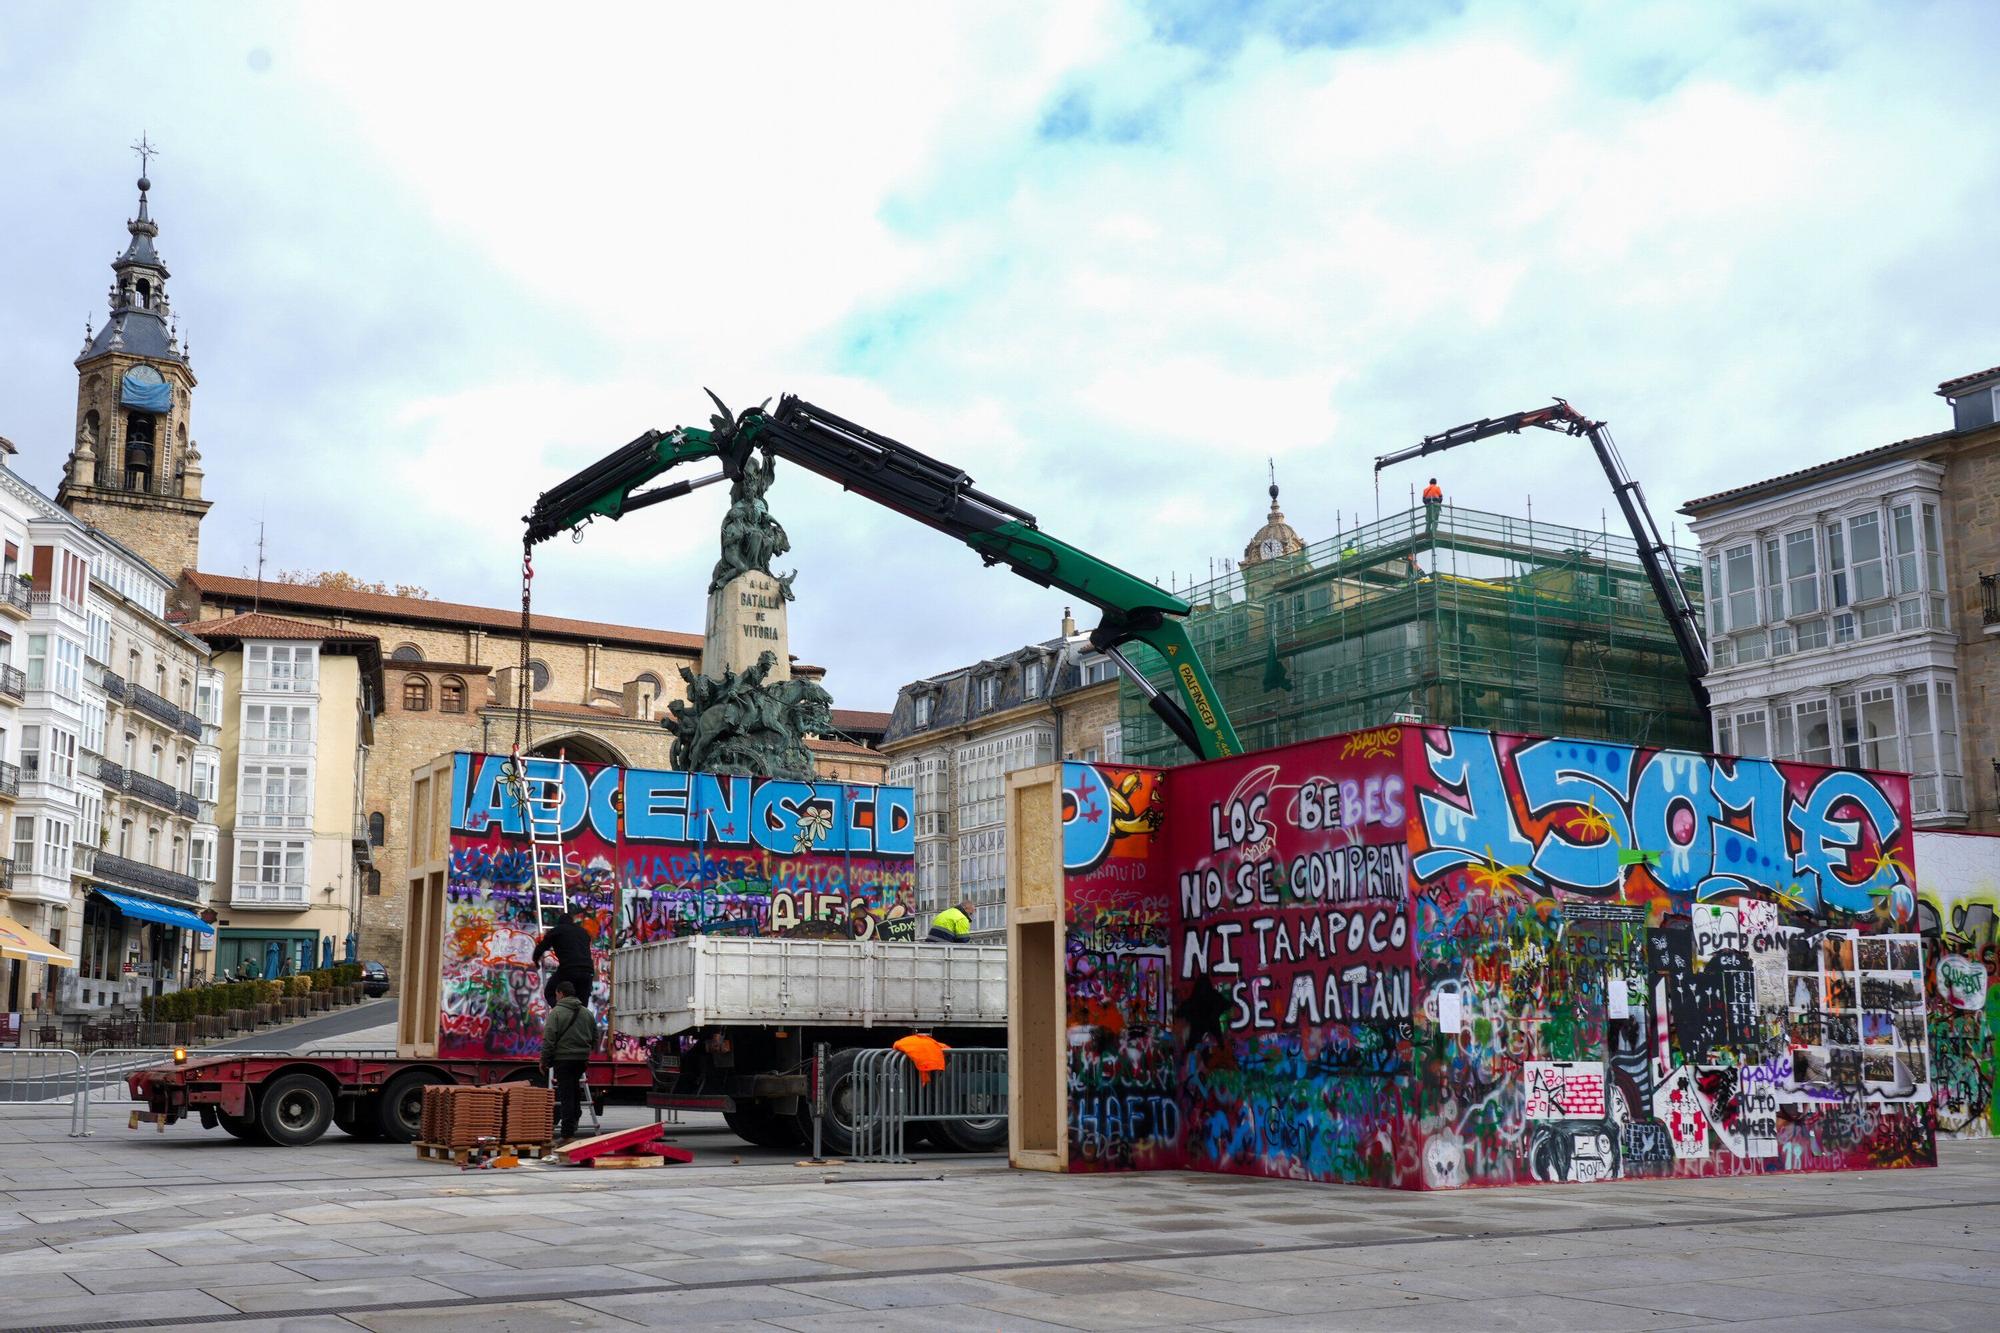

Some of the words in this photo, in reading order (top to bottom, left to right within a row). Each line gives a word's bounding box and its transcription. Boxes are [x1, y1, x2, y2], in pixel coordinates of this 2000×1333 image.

[743, 624, 779, 641] VITORIA
[1181, 666, 1215, 727] PALFINGER
[1211, 793, 1268, 852] LOS
[1298, 774, 1404, 830] BEBES
[1180, 868, 1223, 920] NO
[1235, 858, 1279, 906] SE
[1289, 841, 1409, 902] COMPRAN
[1182, 923, 1243, 979] NI
[1251, 910, 1408, 964] TAMPOCO
[1229, 974, 1277, 1030] SE
[1283, 963, 1411, 1026] MATAN
[1739, 993, 1747, 1003] 6
[1749, 1016, 1756, 1026] 3
